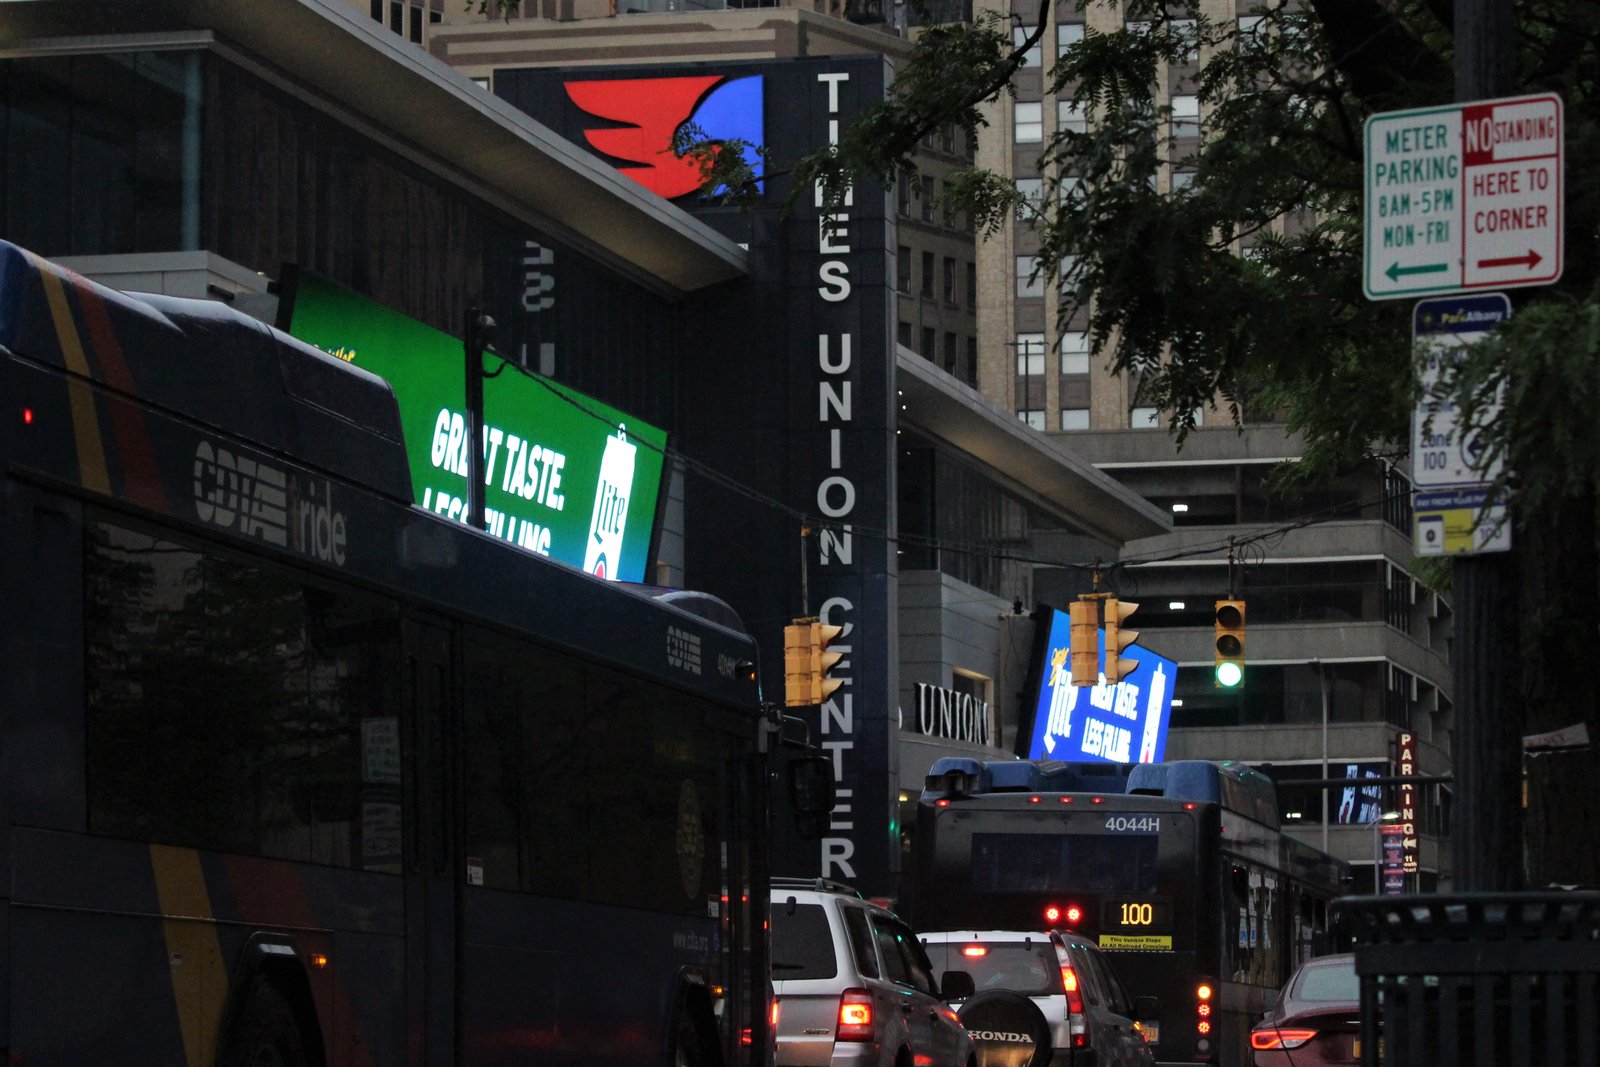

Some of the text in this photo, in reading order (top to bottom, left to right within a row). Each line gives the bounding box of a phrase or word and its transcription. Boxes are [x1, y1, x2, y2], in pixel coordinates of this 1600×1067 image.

[1386, 125, 1448, 154] METER
[1466, 116, 1555, 153] NO STANDING
[1375, 155, 1458, 187] PARKING
[1473, 168, 1549, 197] HERE TO
[1378, 189, 1454, 218] 8AM-5PM
[1383, 220, 1449, 248] MON-FRI
[1474, 205, 1548, 234] CORNER
[431, 408, 504, 487] GRET
[502, 434, 566, 512] TASTE.
[816, 333, 856, 565] UNION
[1423, 451, 1447, 470] 100
[819, 597, 857, 878] CENTER
[1401, 733, 1415, 835] PARKING
[1105, 817, 1160, 832] 4044H
[1120, 903, 1153, 925] 100
[967, 1030, 1034, 1043] HONDA
